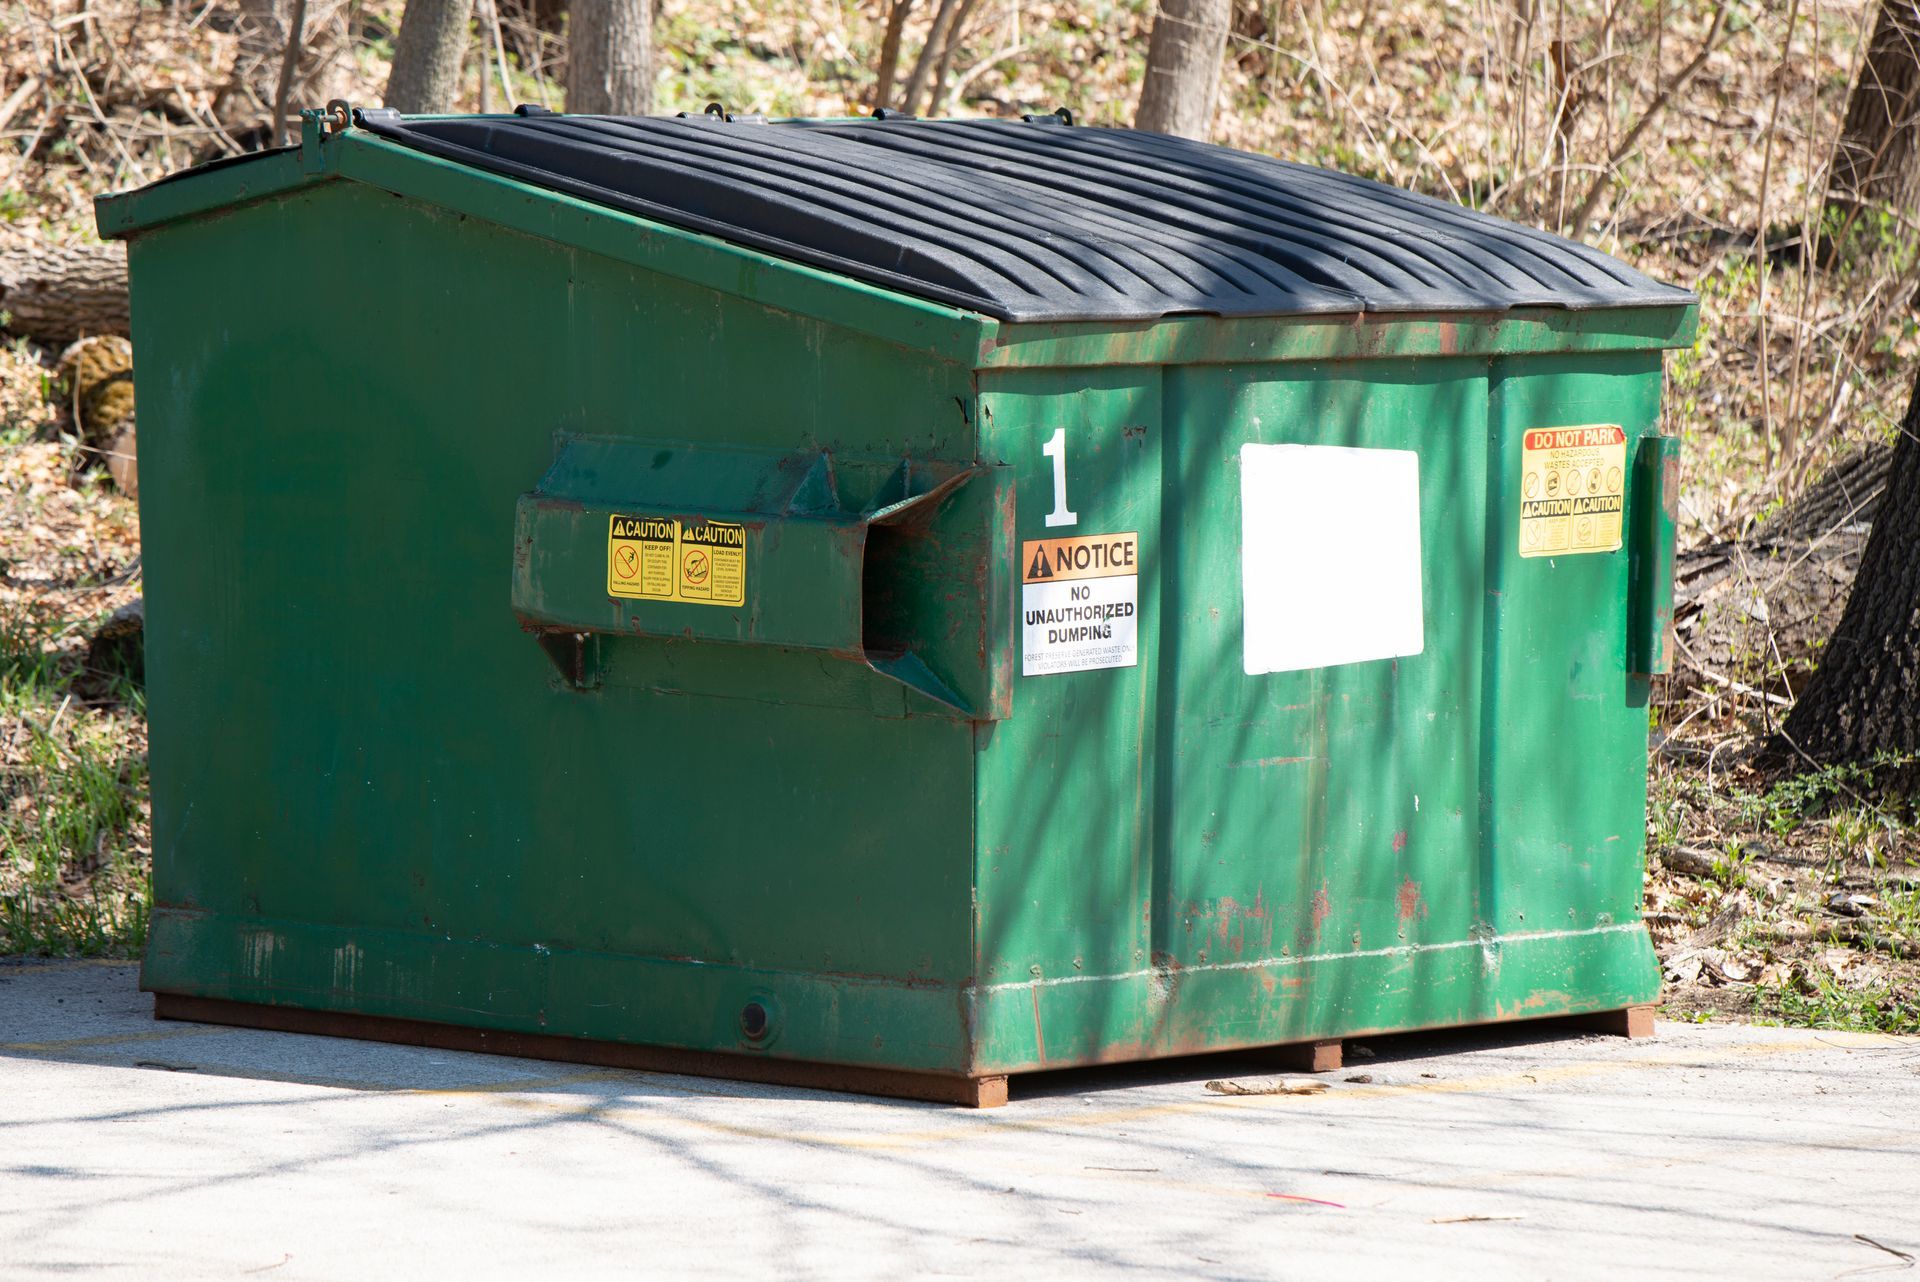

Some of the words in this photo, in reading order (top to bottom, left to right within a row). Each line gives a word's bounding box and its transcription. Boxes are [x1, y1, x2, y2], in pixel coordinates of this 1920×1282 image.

[1534, 433, 1553, 448] DO
[1556, 431, 1581, 446] NOT
[1584, 428, 1616, 445] PARK
[1550, 450, 1559, 458] NO
[1561, 448, 1600, 457] HAZARDOUS
[1545, 460, 1570, 469] WASTES
[1572, 458, 1605, 467] ACCEPTED
[1043, 428, 1077, 527] 1
[1531, 500, 1570, 516] CAUTION
[1582, 496, 1620, 512] CAUTION
[626, 520, 673, 539] CAUTION
[695, 527, 742, 545] CAUTION
[1057, 541, 1134, 572] NOTICE
[1071, 586, 1090, 601] NO
[1026, 602, 1134, 626] UNAUTHORIZED
[1048, 624, 1112, 644] DUMPING
[1025, 653, 1043, 662] FOREST
[1072, 648, 1102, 657] GENERATED
[1103, 645, 1120, 654] WASTE
[1038, 661, 1067, 670] VIOLATORS
[1068, 659, 1080, 667] WILL
[1081, 658, 1088, 666] BE
[1089, 655, 1123, 664] PROSECUTED
